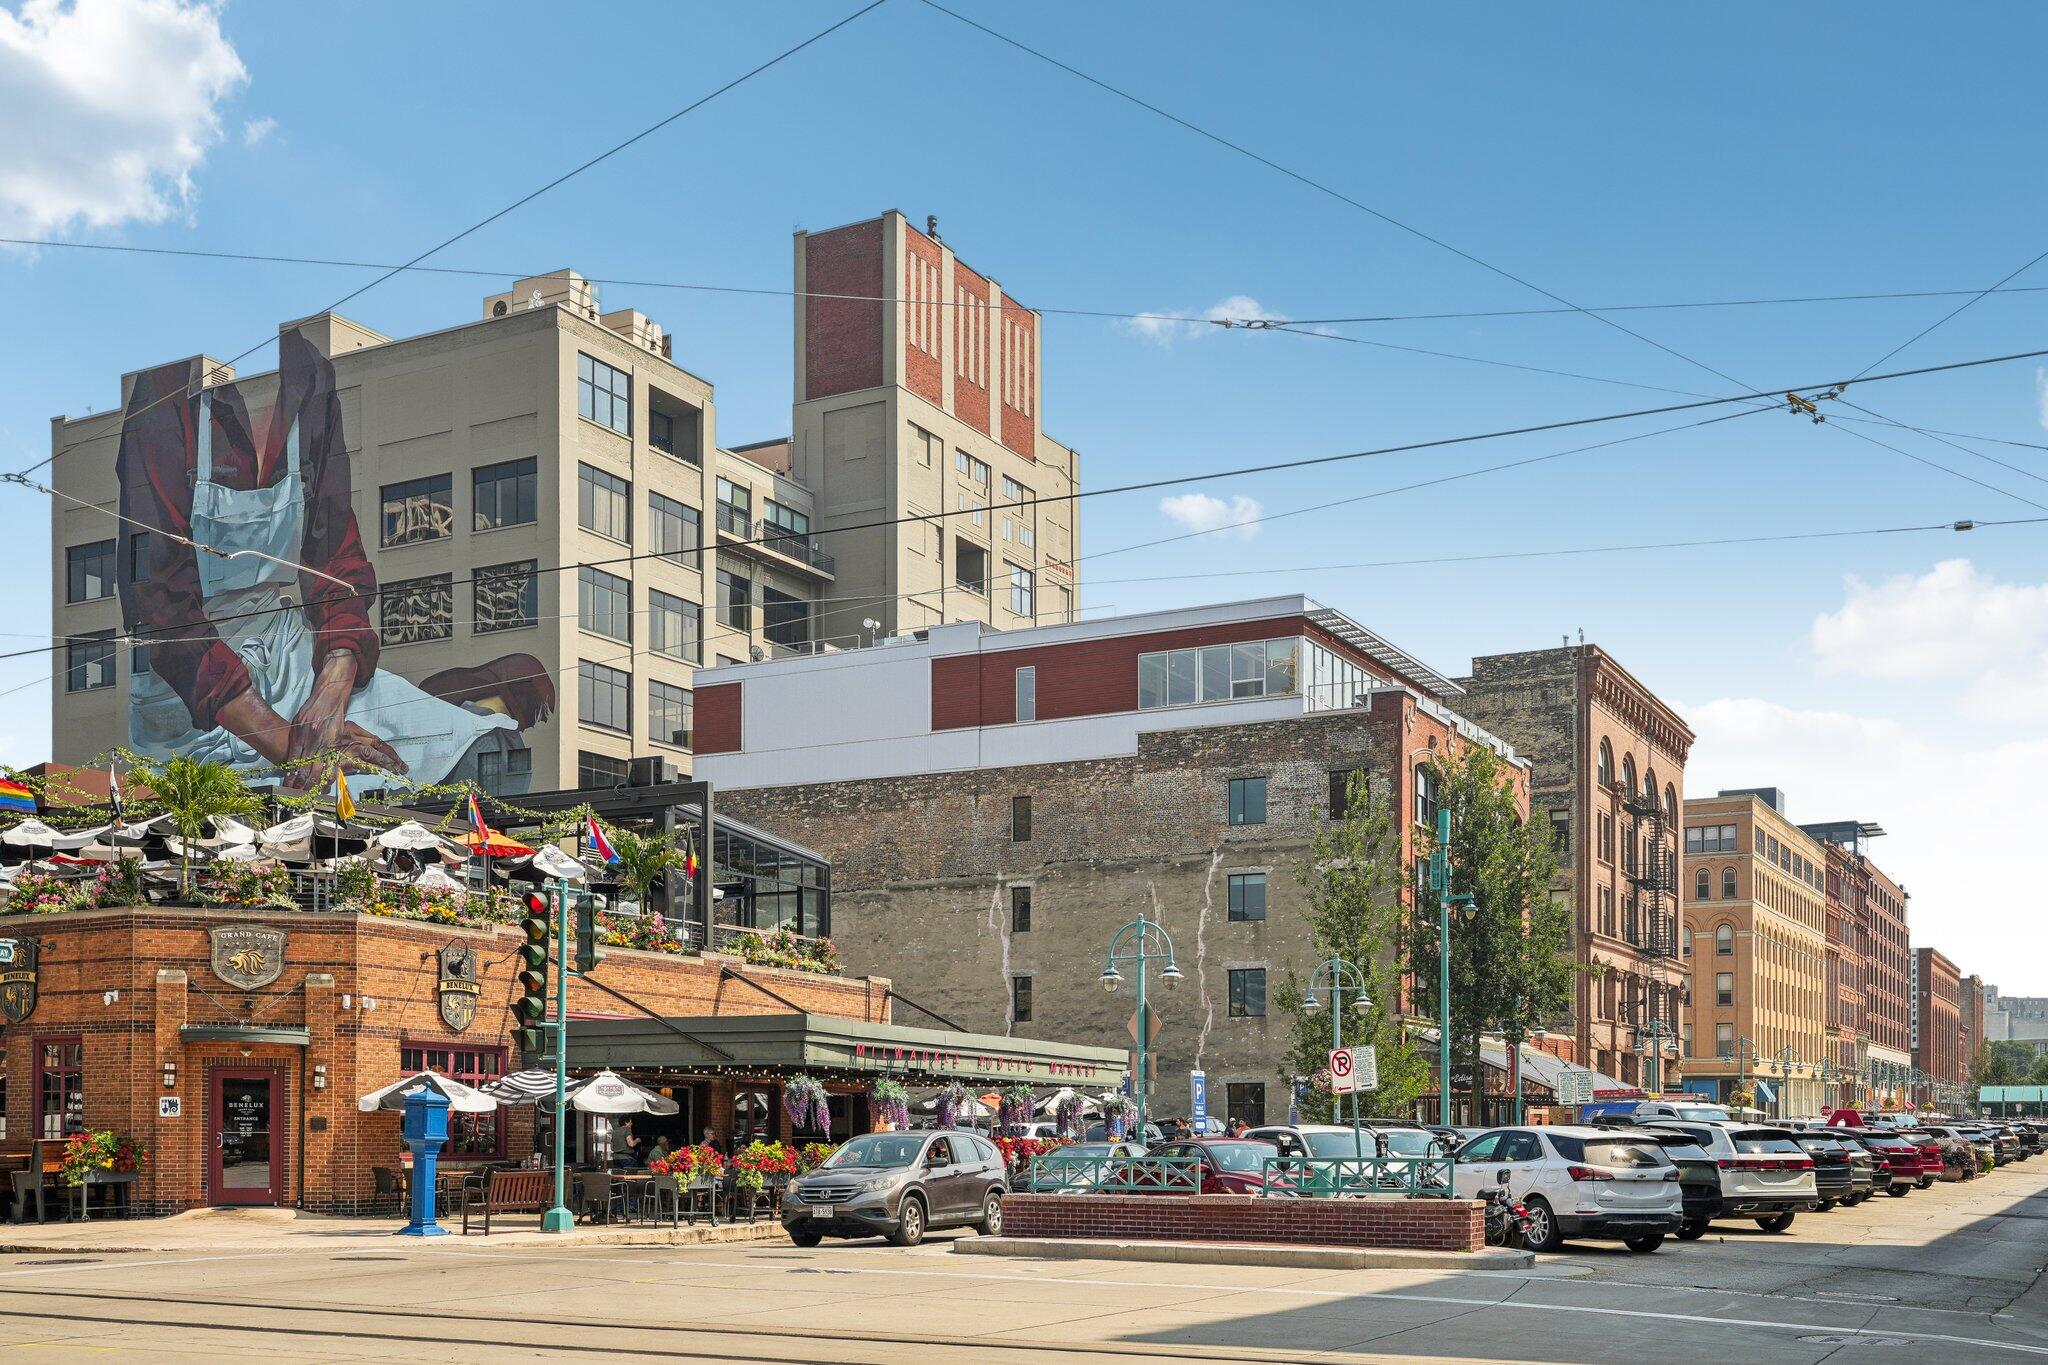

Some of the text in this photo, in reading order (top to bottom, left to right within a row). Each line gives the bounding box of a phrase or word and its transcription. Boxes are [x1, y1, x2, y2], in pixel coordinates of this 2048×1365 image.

[221, 931, 278, 941] GRAND CAFE
[4, 972, 29, 980] BENELUX
[446, 981, 474, 991] BENELUX
[856, 1043, 1097, 1078] MILWAUKEE PUBLIC MARKET
[1454, 1073, 1473, 1083] Ediso
[1196, 1083, 1202, 1100] P
